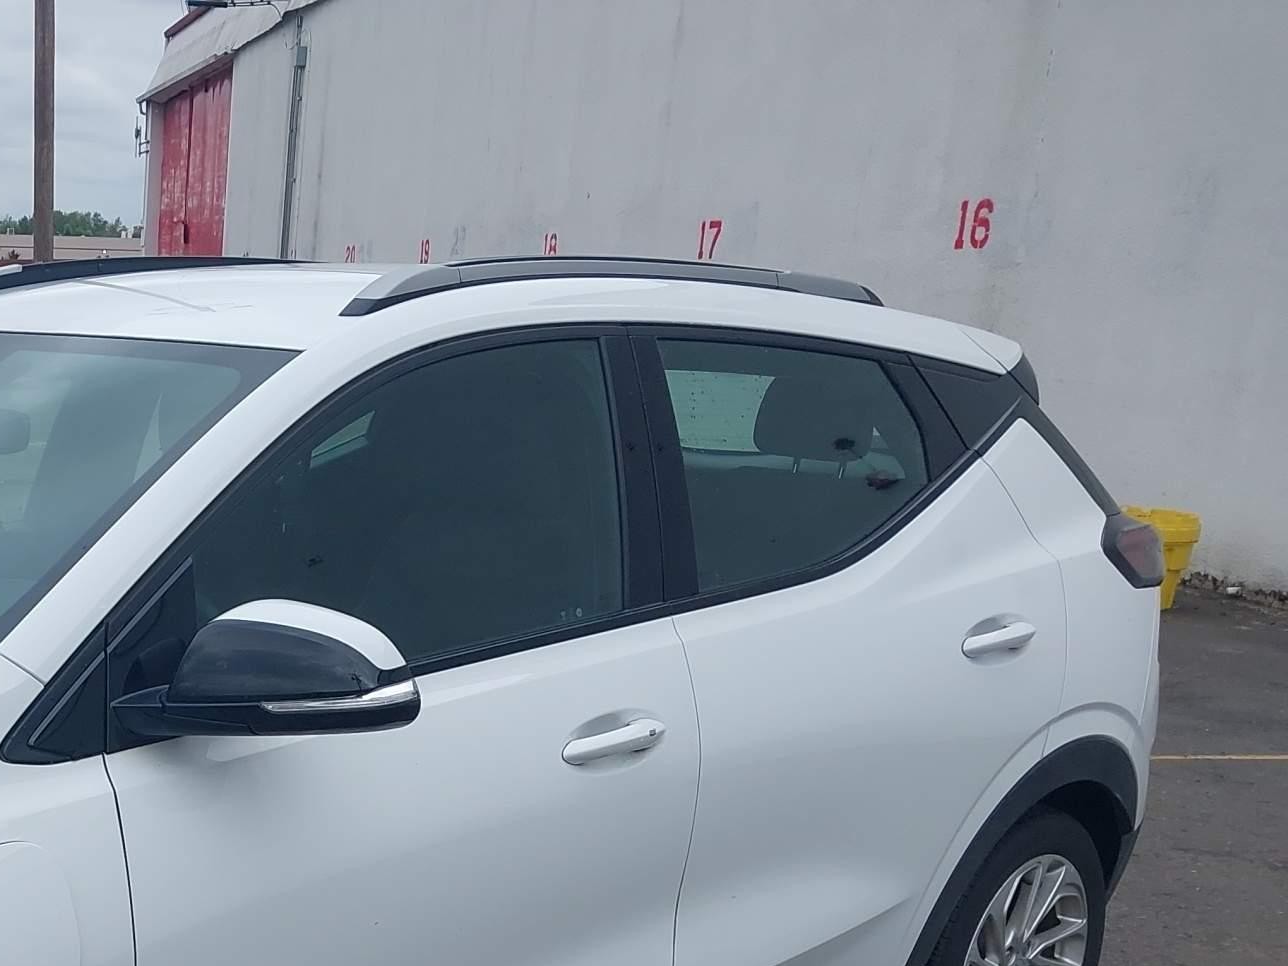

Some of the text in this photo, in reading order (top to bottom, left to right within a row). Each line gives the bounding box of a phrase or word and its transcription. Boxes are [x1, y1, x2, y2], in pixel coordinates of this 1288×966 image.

[697, 219, 722, 260] 17
[954, 198, 994, 250] 16
[345, 244, 356, 263] 20
[419, 239, 430, 264] 19
